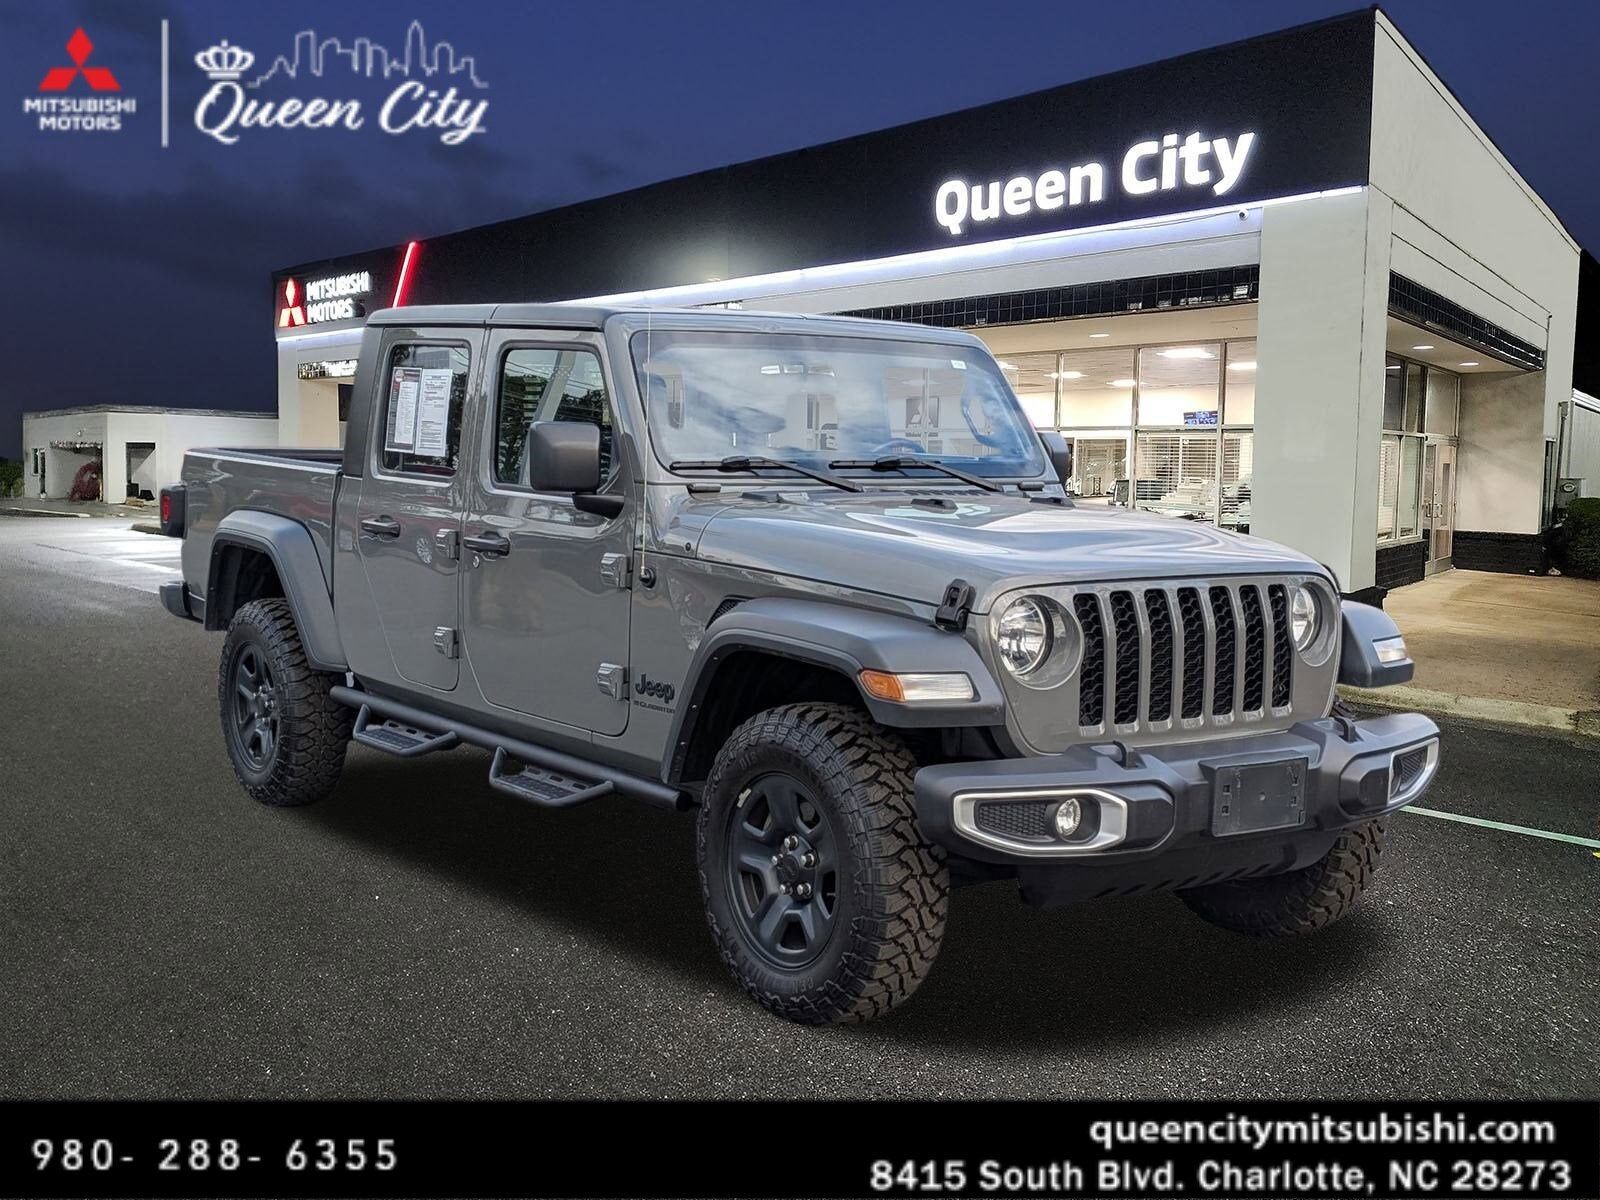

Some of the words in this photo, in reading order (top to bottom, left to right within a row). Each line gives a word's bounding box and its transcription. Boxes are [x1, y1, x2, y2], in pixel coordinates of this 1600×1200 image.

[935, 162, 1104, 235] Queen
[1121, 131, 1256, 196] City
[305, 270, 371, 302] MITSUBISHI
[306, 297, 354, 324] MOTORS
[635, 673, 675, 704] Jeep
